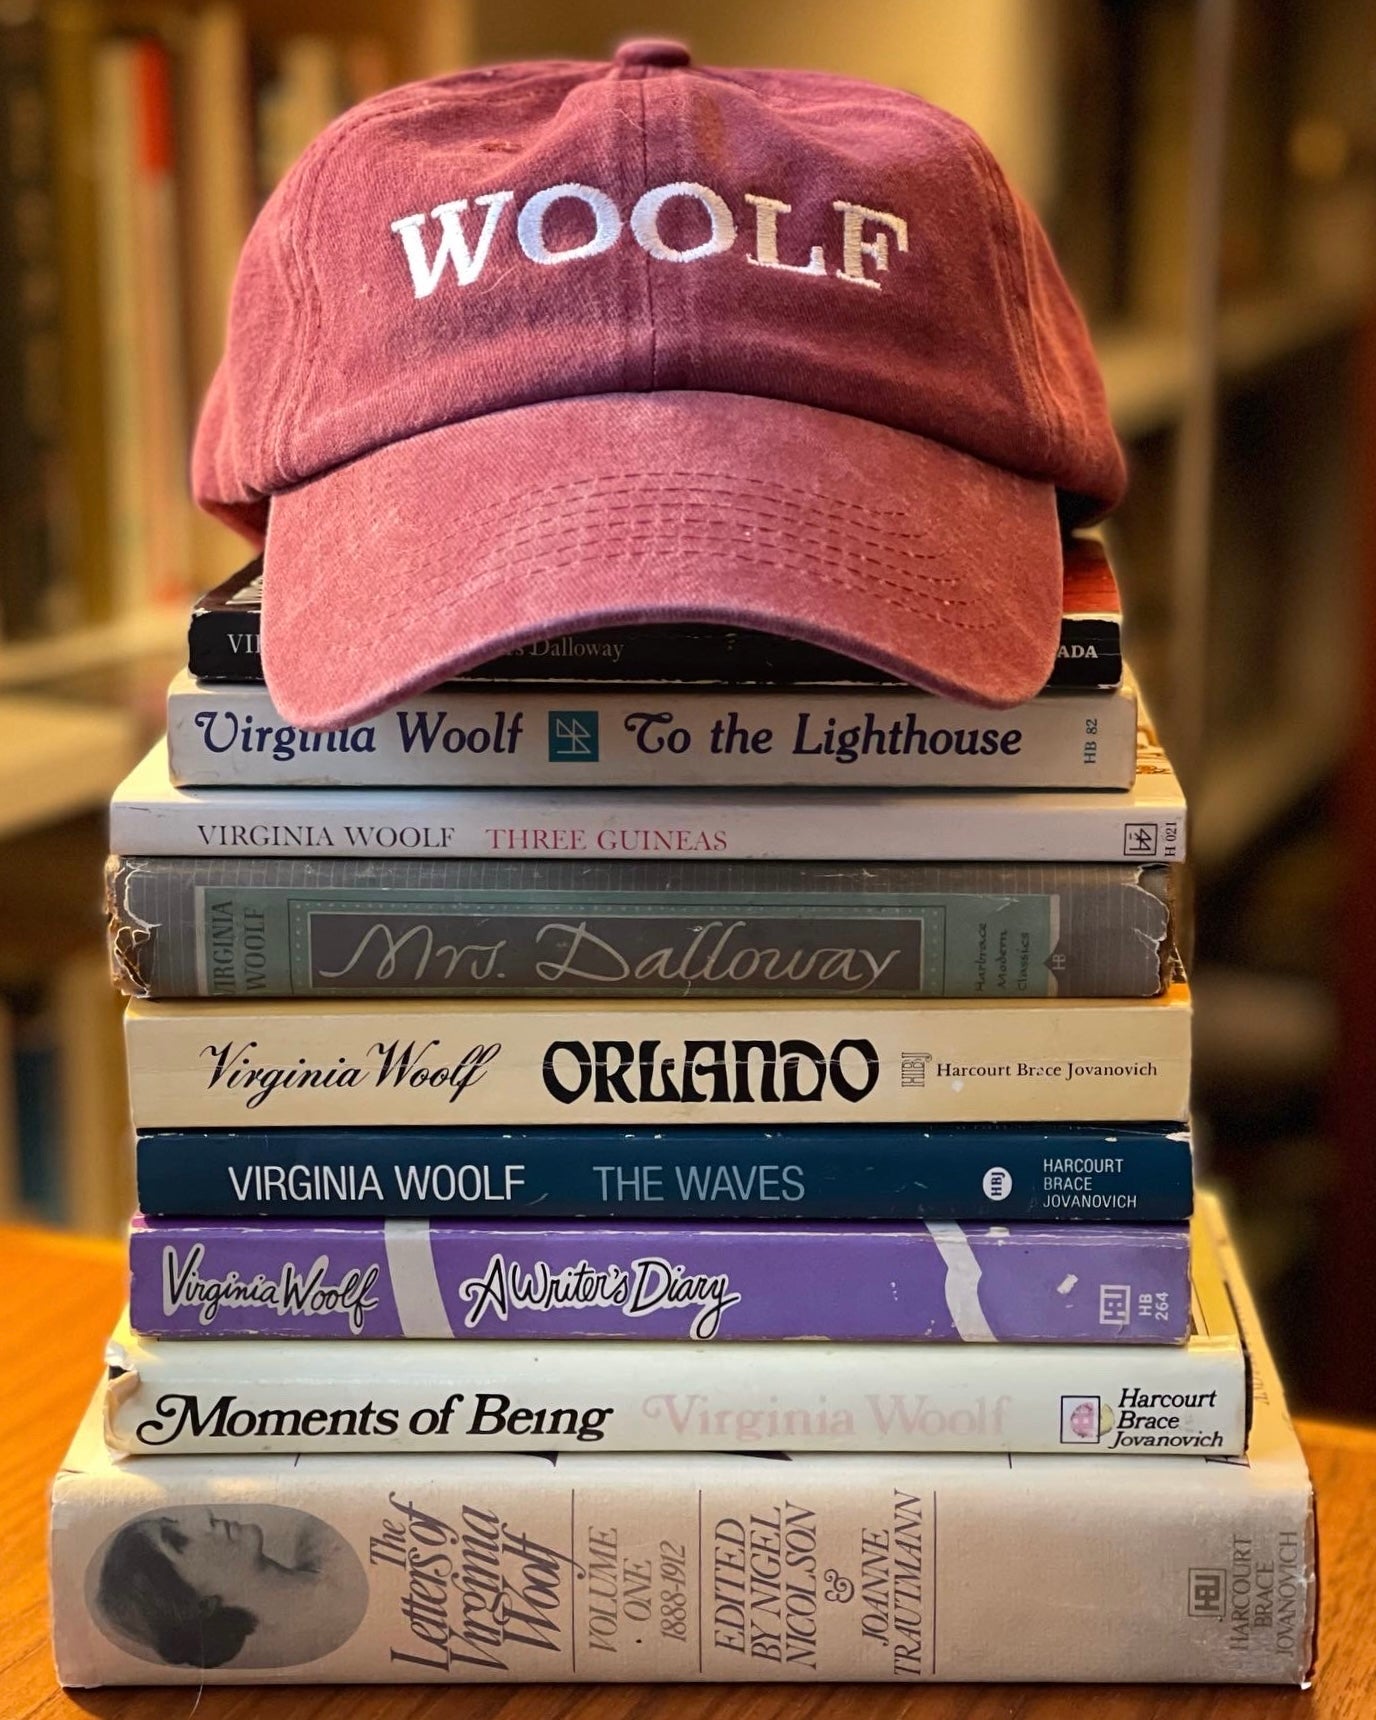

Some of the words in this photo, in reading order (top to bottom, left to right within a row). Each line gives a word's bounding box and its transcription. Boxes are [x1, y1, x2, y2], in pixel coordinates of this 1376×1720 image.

[391, 182, 908, 299] WOOLF
[531, 636, 624, 663] Dalloway
[397, 711, 524, 754] Woolf
[624, 712, 692, 754] To
[710, 712, 774, 755] the
[791, 711, 1023, 764] Lighthouse
[1084, 741, 1097, 764] HB
[1086, 718, 1097, 735] 82
[199, 825, 334, 847] VIRGINIA
[344, 825, 456, 848] WOOLF
[485, 829, 586, 851] THREE
[597, 830, 728, 853] GUINEAS
[1165, 846, 1176, 857] H
[244, 907, 266, 991] WOOLF
[319, 923, 506, 981] Mrs.
[536, 920, 902, 993] Dalloway
[1052, 954, 1066, 970] HB
[199, 1041, 365, 1110] Virginia
[366, 1039, 502, 1103] Woolf
[541, 1038, 880, 1104] ORLANDO
[936, 1062, 1011, 1077] Harcourt
[1017, 1062, 1062, 1077] Brace
[1065, 1062, 1158, 1081] Jovanovich
[228, 1165, 384, 1201] VIRGINIA
[394, 1165, 525, 1201] WOOLF
[593, 1166, 663, 1201] THE
[675, 1166, 806, 1201] WAVES
[991, 1172, 1005, 1196] HBJ
[1043, 1158, 1124, 1173] HARCOURT
[1043, 1177, 1092, 1191] BRACE
[1043, 1195, 1137, 1209] JOVANOVICH
[162, 1244, 279, 1324] Virginia
[280, 1255, 380, 1334] Woolf
[630, 1256, 742, 1340] Diary
[1138, 1294, 1152, 1316] HB
[1155, 1292, 1169, 1321] 264
[136, 1393, 398, 1446] Moments
[408, 1393, 463, 1436] of
[465, 1395, 614, 1443] Being
[642, 1395, 855, 1440] Virginia
[867, 1395, 1012, 1436] Woolf
[1116, 1410, 1180, 1430] Brace
[1118, 1388, 1218, 1408] Harcourt
[1108, 1431, 1224, 1449] Jovanovich
[370, 1518, 407, 1571] The
[389, 1491, 459, 1546] of
[450, 1504, 513, 1671] Virginia
[501, 1522, 586, 1653] Woolf
[714, 1518, 746, 1653] EDITED
[751, 1506, 781, 1618] NIGEL
[785, 1500, 817, 1670] NICOLSON
[824, 1568, 855, 1604] &
[861, 1527, 890, 1647] JOANNE
[894, 1488, 922, 1676] TRAUTMANN
[390, 1546, 454, 1673] Letters
[588, 1526, 618, 1653] VOLUME
[623, 1558, 652, 1622] ONE
[659, 1540, 687, 1643] 1888-1912
[1230, 1534, 1252, 1651] HARCOURT
[1254, 1560, 1274, 1628] BRACE
[1276, 1531, 1298, 1657] JOVANOVICH
[751, 1619, 782, 1664] BY
